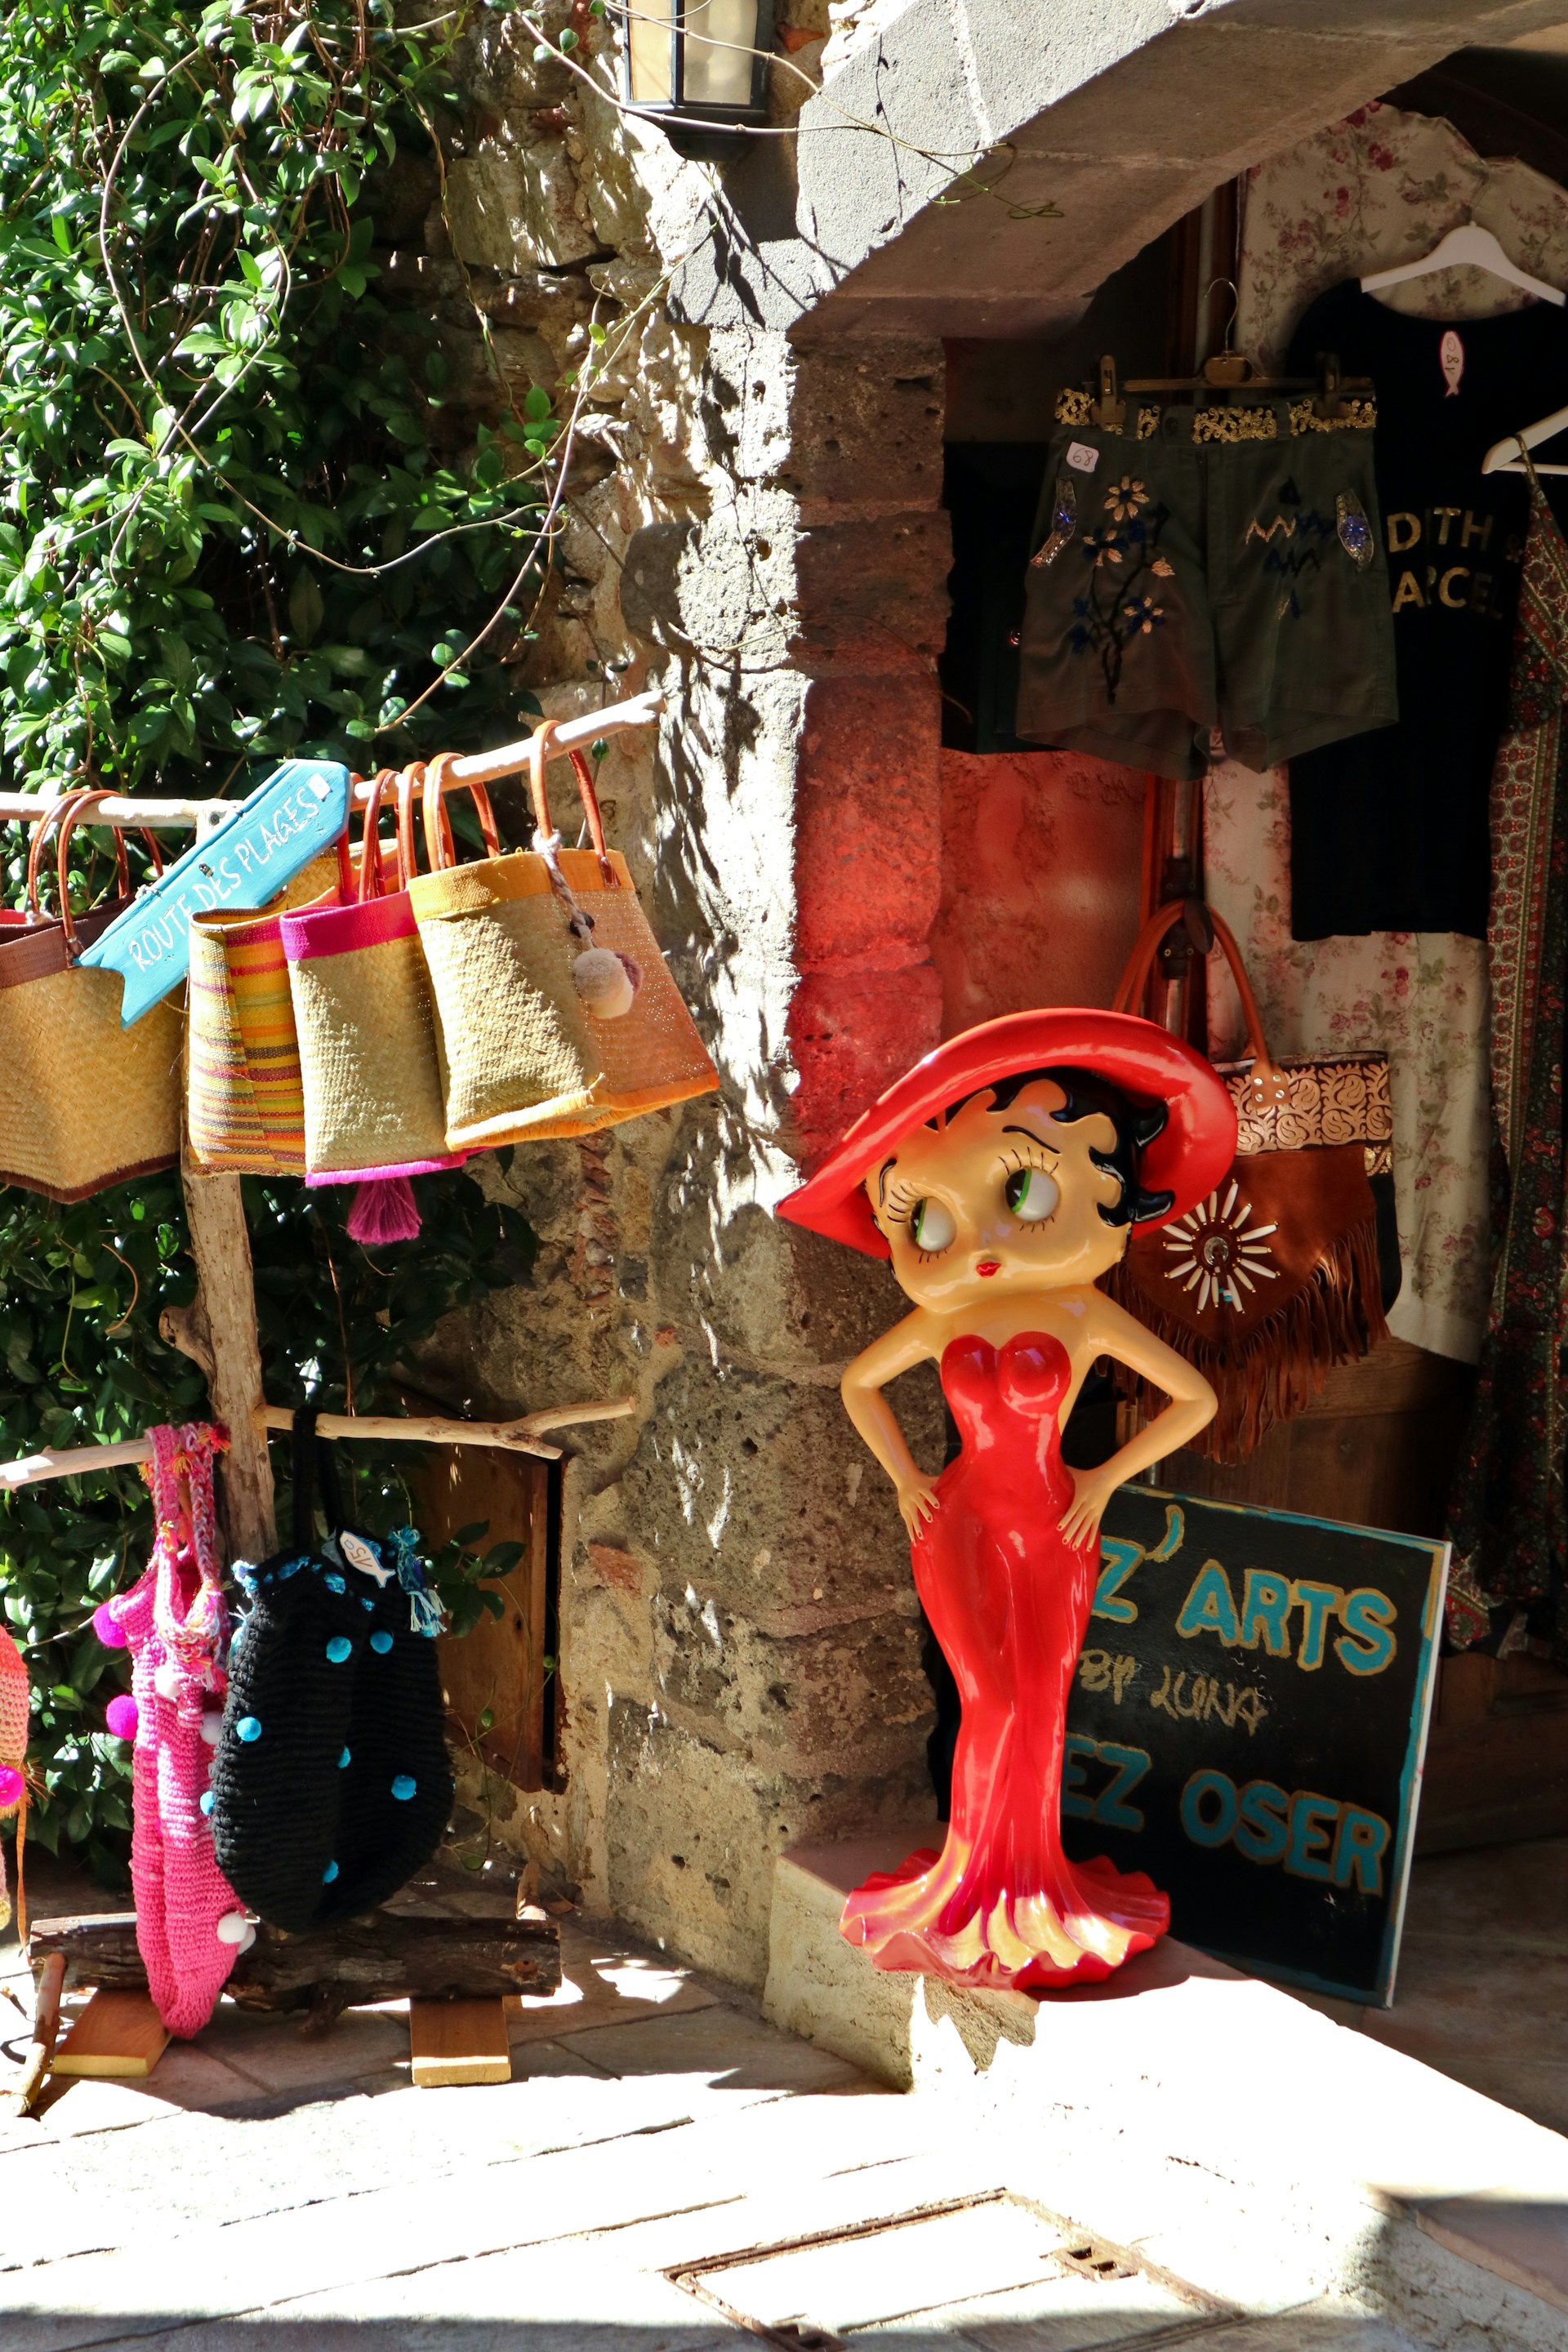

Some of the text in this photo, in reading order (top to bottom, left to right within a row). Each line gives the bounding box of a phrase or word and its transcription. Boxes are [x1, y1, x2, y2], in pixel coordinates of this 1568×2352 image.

[1072, 448, 1094, 466] 68
[129, 786, 320, 972] ROUTE DES PLAGES
[1179, 1768, 1392, 1897] OSER
